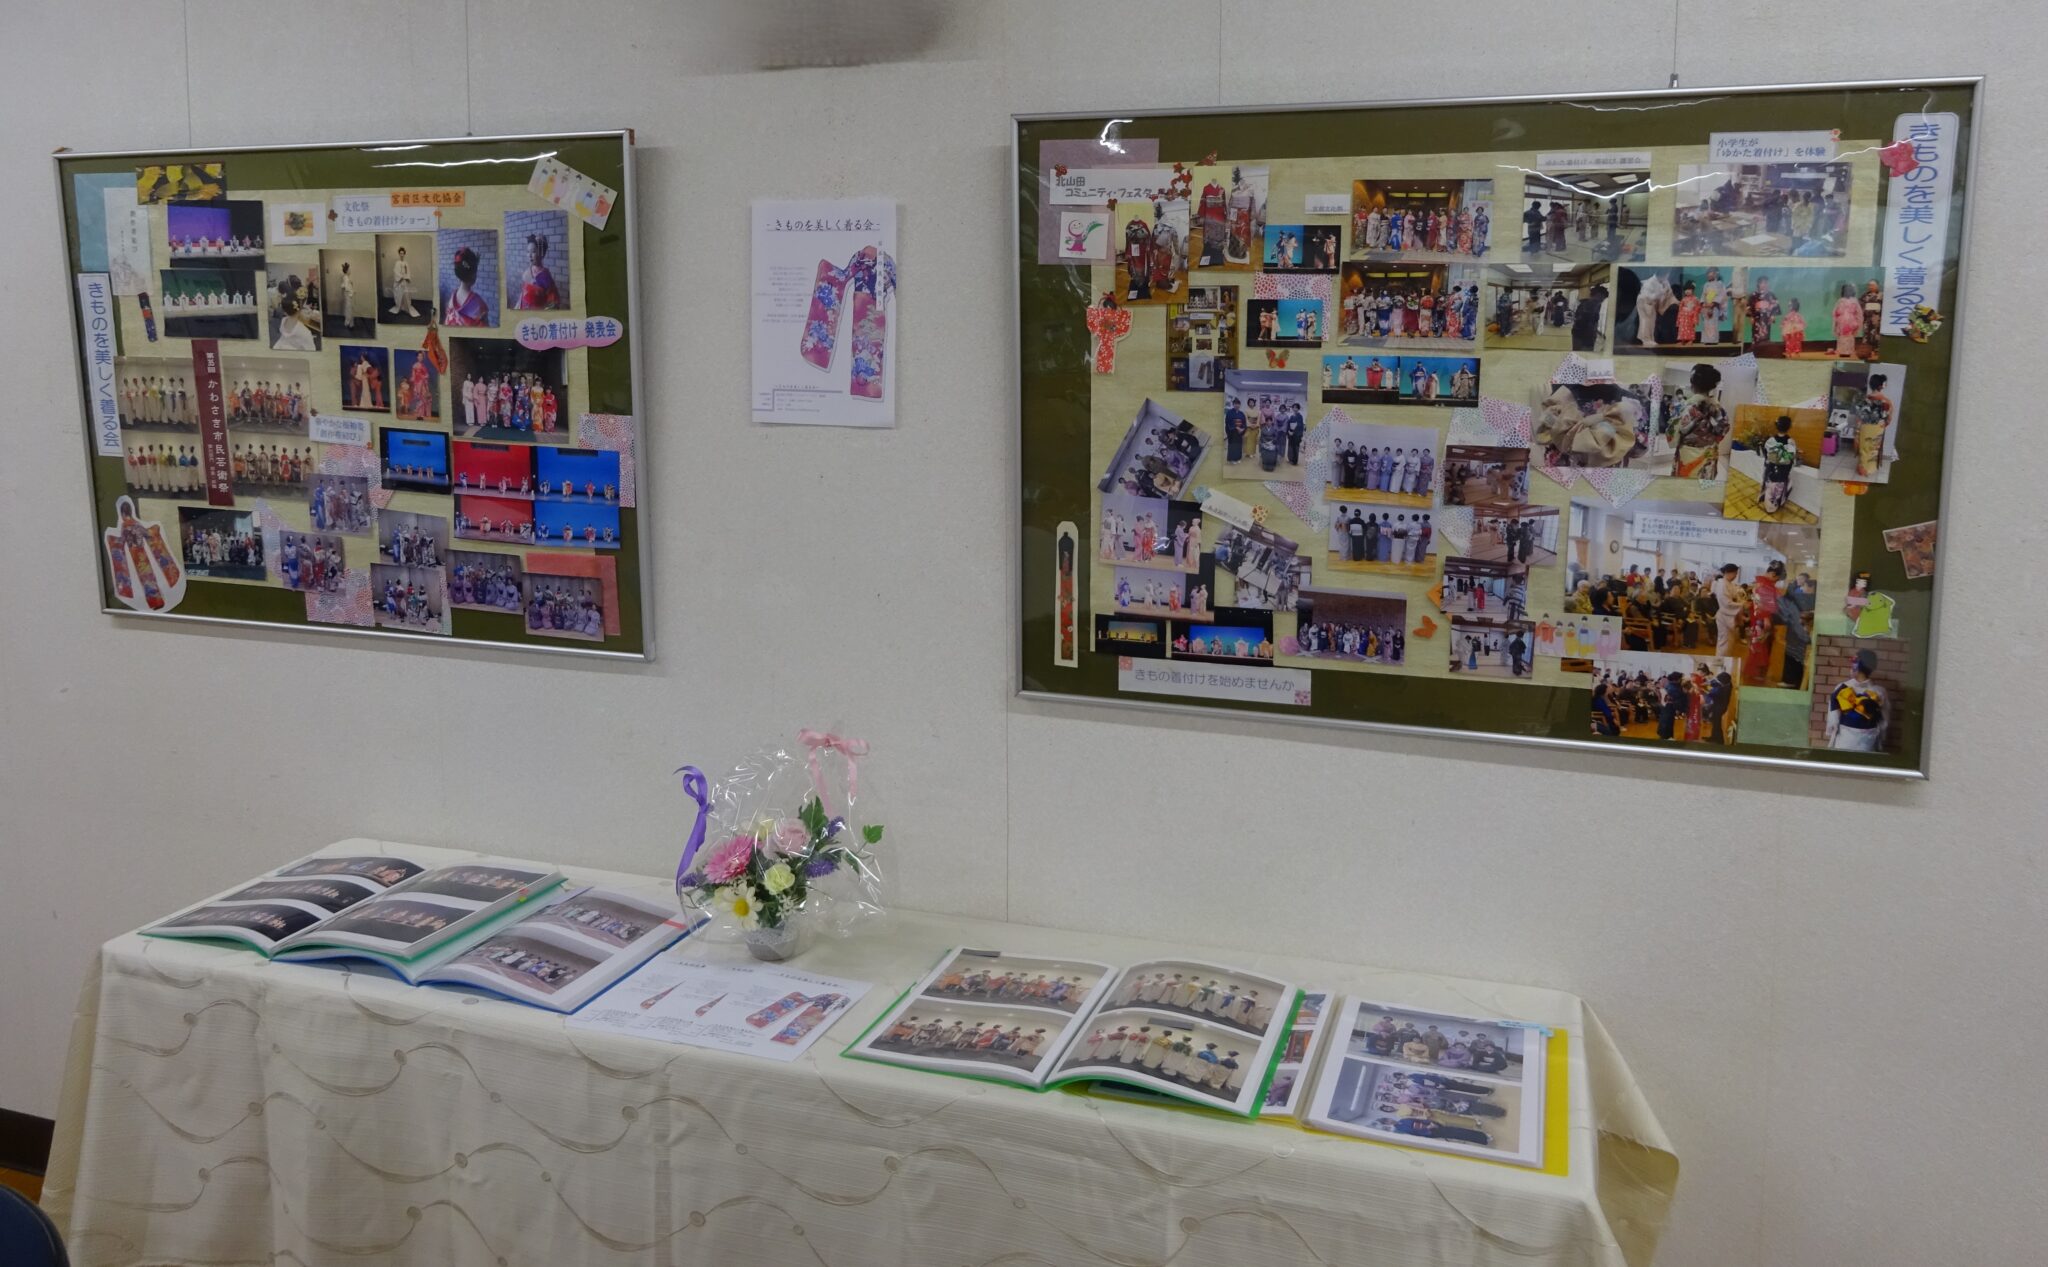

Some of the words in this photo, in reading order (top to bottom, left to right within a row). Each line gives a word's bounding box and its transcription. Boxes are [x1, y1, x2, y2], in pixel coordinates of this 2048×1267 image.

[1718, 138, 1759, 147] 小学生が
[1055, 176, 1086, 187] 北山田
[343, 202, 369, 213] 文化祭
[391, 192, 463, 205] 宮前区文化協会
[521, 322, 578, 342] きもの着付け
[584, 319, 617, 338] 発表会
[87, 282, 120, 448] きものを美しく着る会
[207, 379, 229, 494] かわさき市民芸術祭
[1134, 668, 1296, 693] きもの着付けを始めませんか
